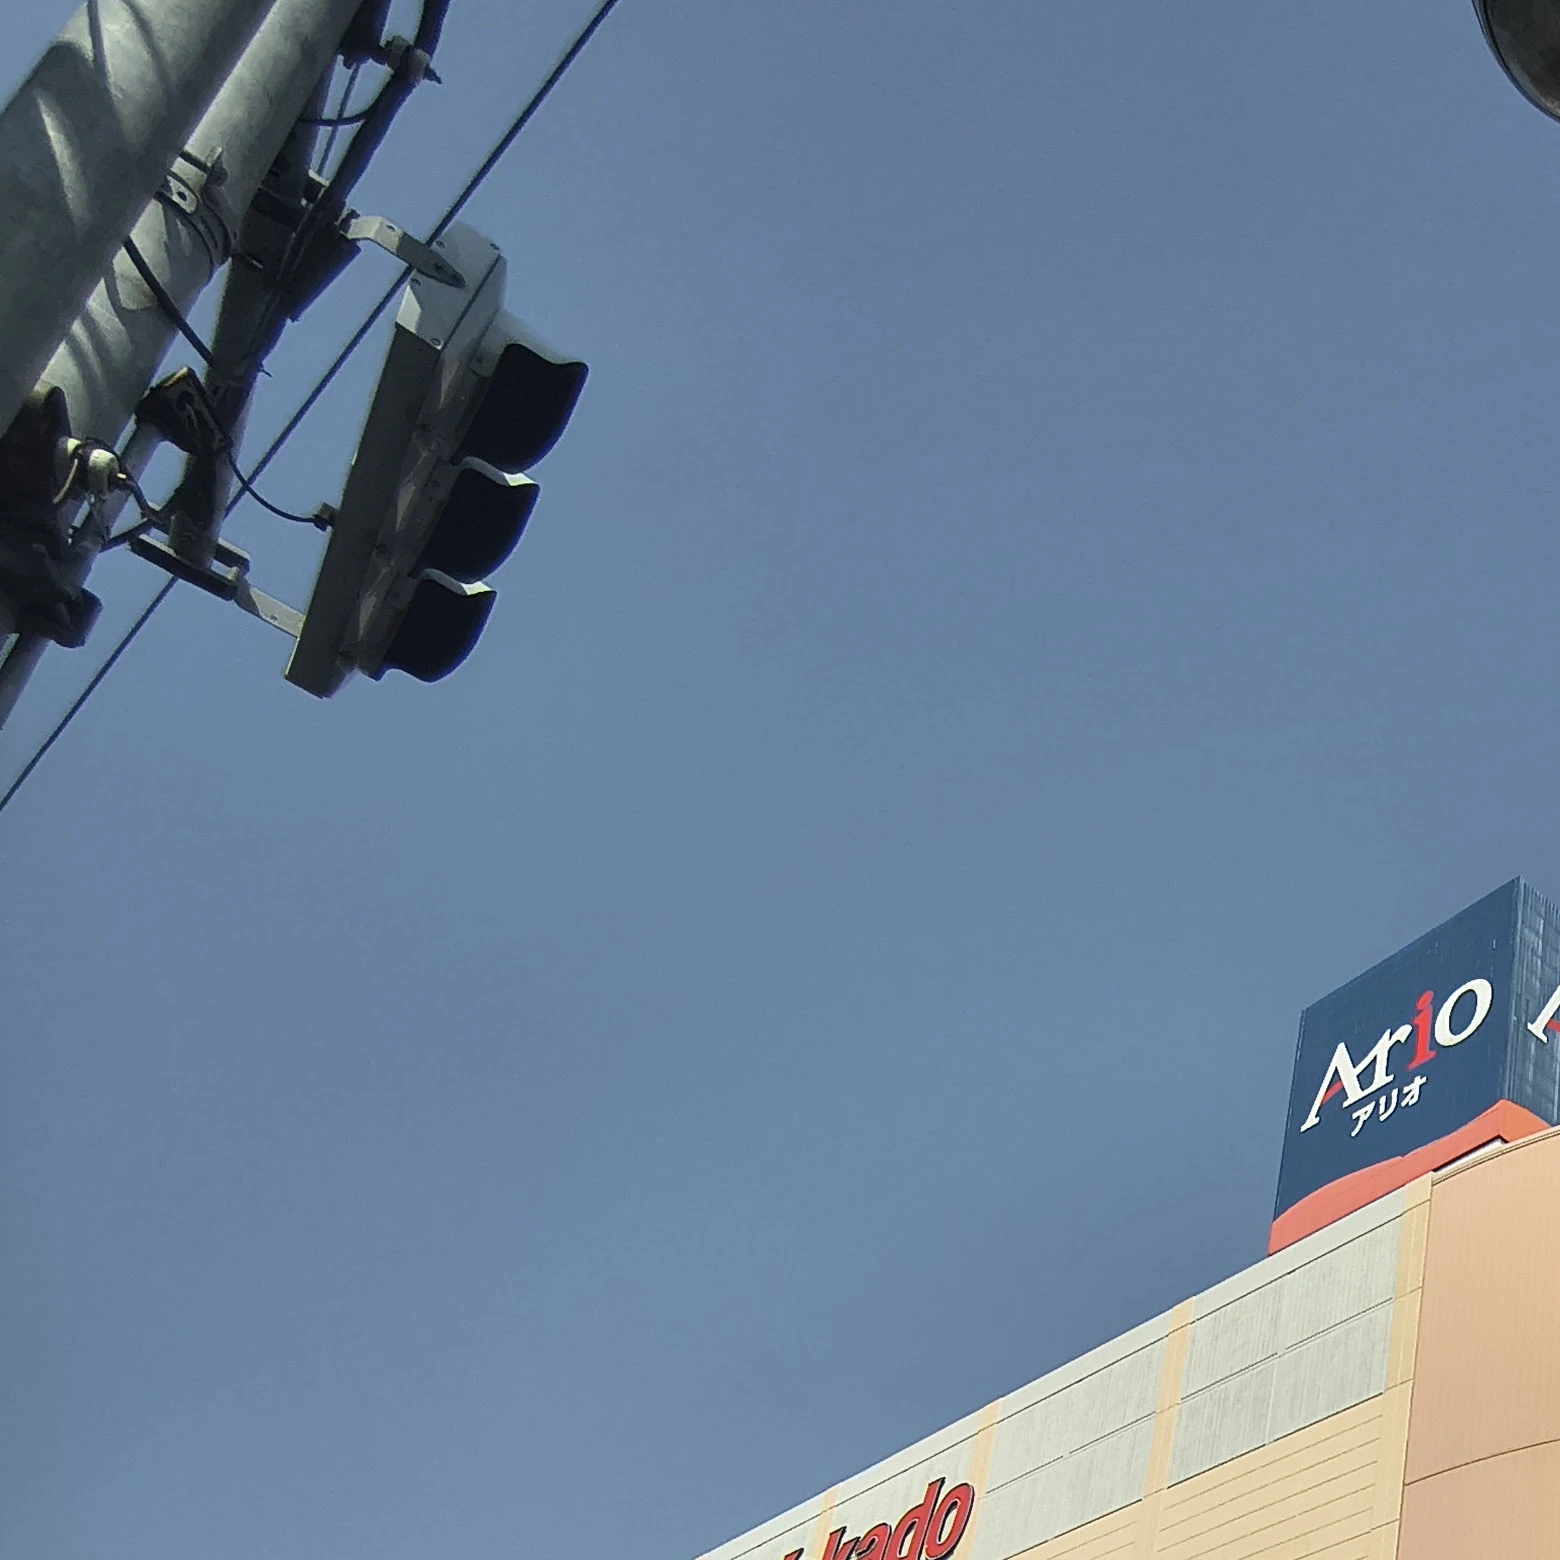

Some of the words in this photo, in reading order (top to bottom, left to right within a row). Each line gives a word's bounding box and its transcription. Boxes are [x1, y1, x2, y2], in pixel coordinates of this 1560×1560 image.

[1300, 978, 1493, 1132] Ario
[1351, 1075, 1426, 1137] アリオ
